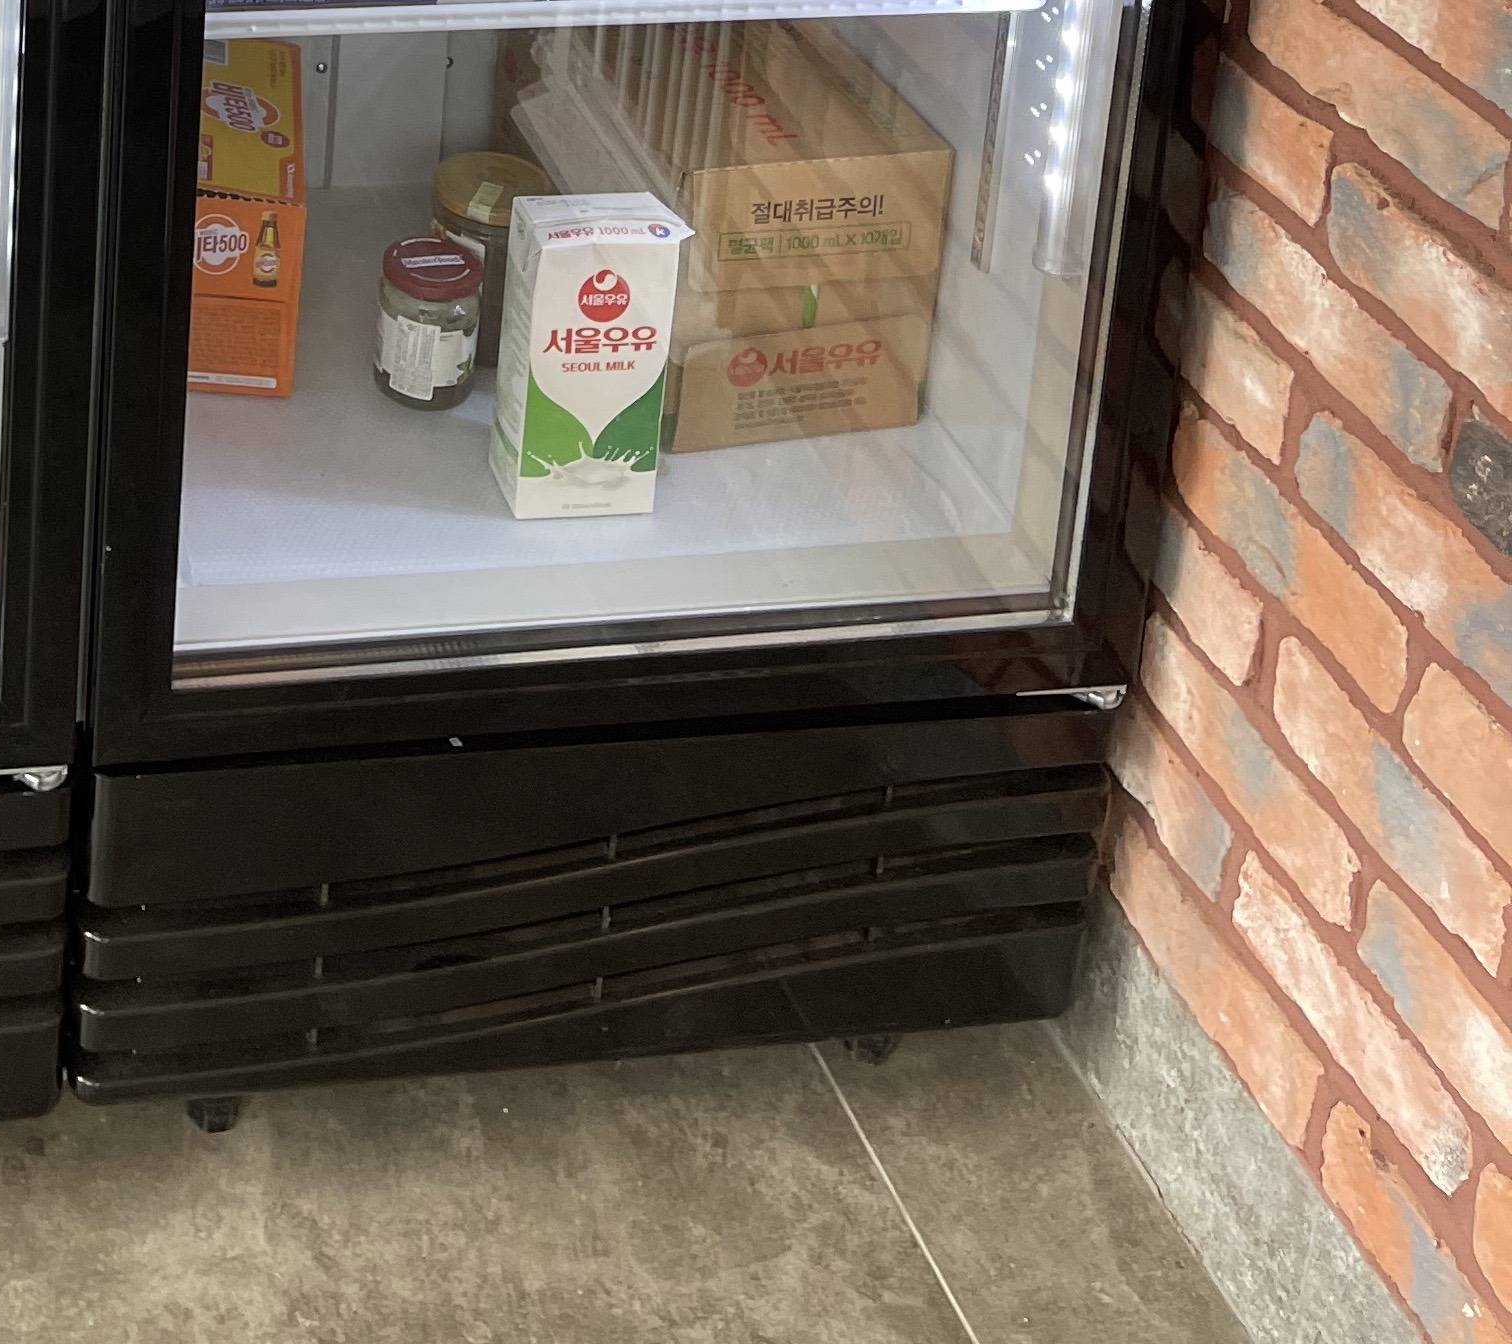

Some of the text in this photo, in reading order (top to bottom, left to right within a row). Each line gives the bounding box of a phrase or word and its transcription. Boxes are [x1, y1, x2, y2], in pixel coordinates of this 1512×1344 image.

[750, 193, 886, 226] 절대취급주의!
[547, 226, 595, 241] 서울우유
[598, 225, 630, 237] 1000
[786, 234, 819, 251] 1000
[579, 292, 629, 307] 서울우유
[541, 325, 658, 355] 서울우유
[767, 338, 883, 377] 서울우유
[560, 359, 636, 374] SEOUL MILK
